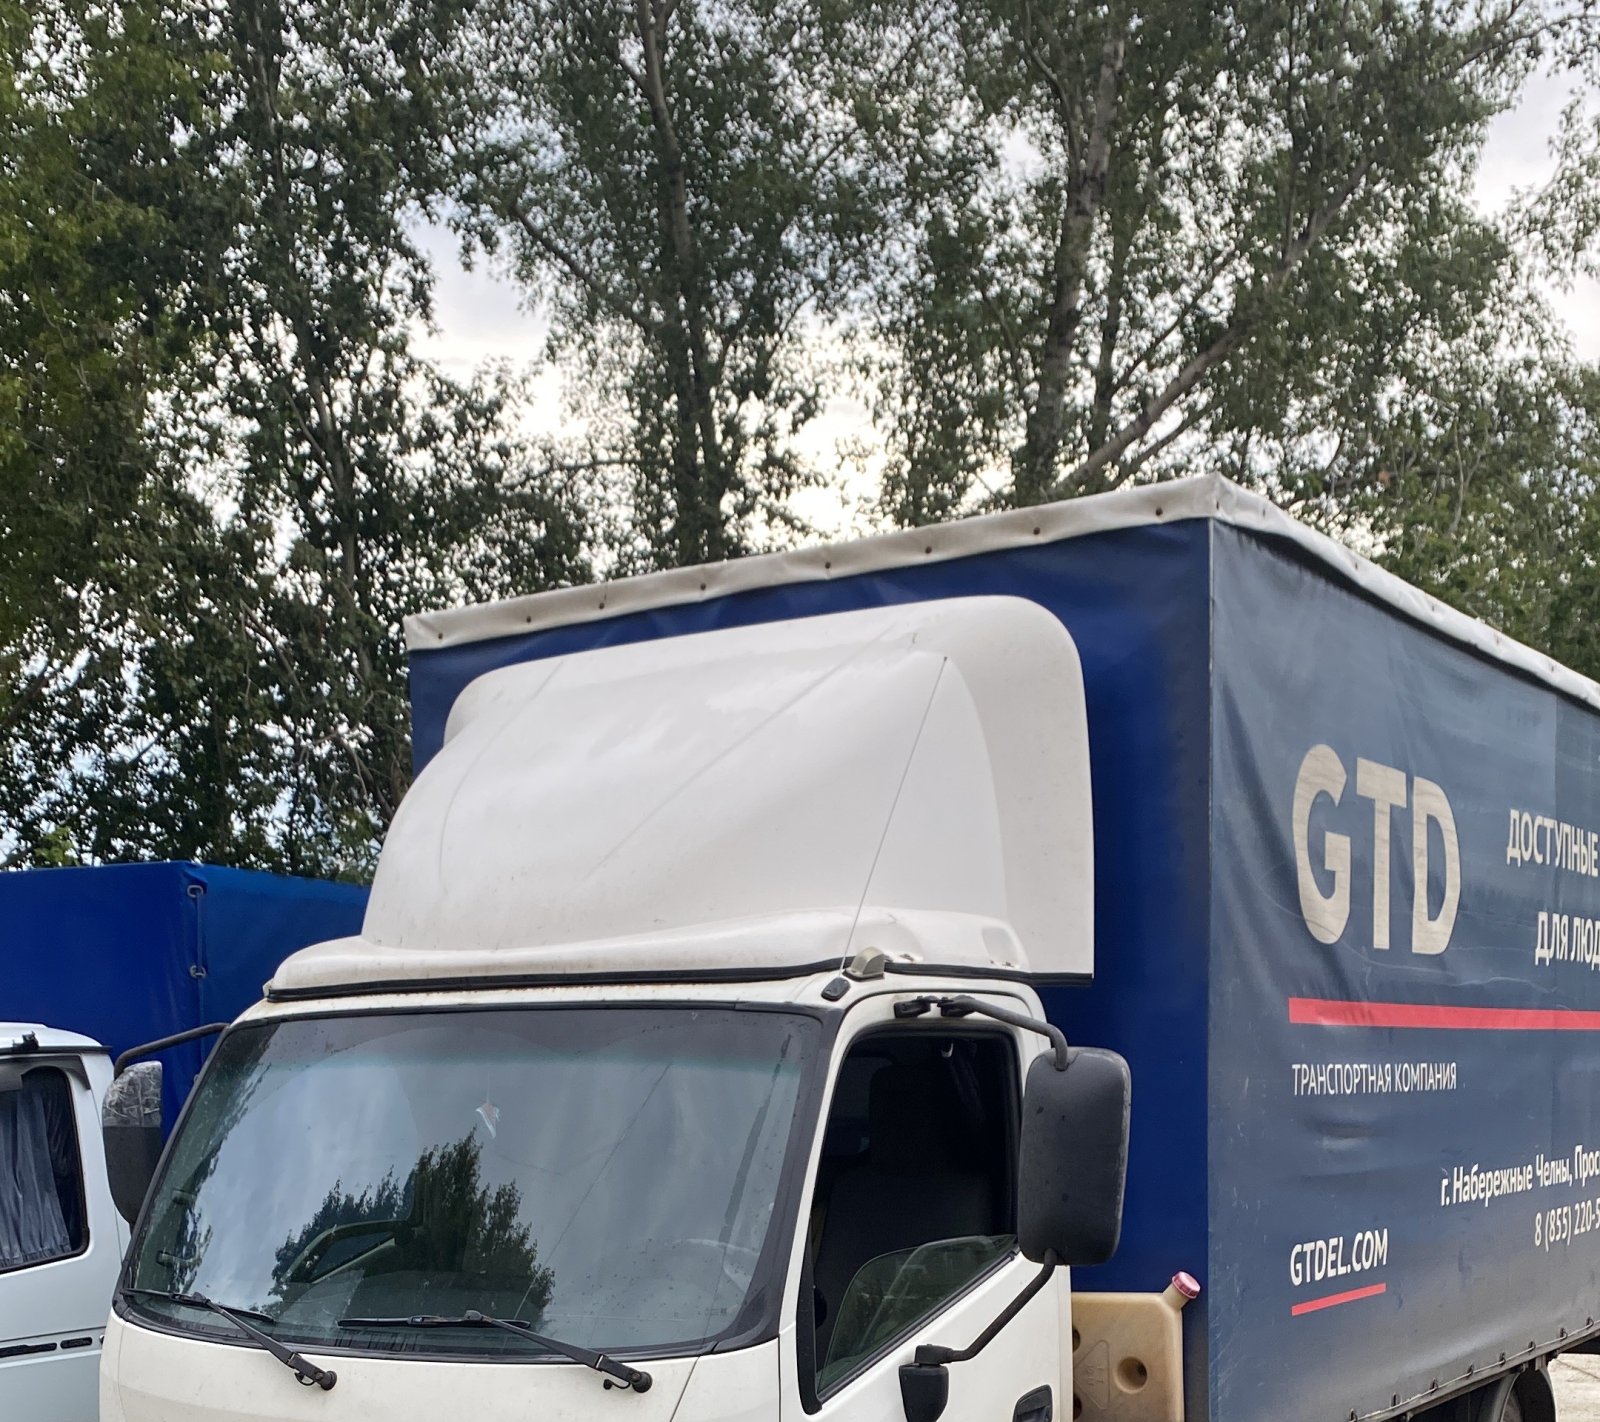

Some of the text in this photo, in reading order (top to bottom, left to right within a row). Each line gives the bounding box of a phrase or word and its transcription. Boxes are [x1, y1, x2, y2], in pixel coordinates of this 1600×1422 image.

[1292, 743, 1461, 955] GTD
[1507, 809, 1598, 877] ДОСТУПНЫЕ
[1535, 911, 1568, 966] ДЛЯ
[1292, 1062, 1457, 1096] ТРАНСПОРТНАЯ КОМПАНИЯ
[1440, 1178, 1450, 1206] г.
[1453, 1163, 1533, 1207] Набережные
[1536, 1153, 1572, 1187] Челны,
[1534, 1212, 1542, 1246] 8
[1545, 1205, 1571, 1252] (855)
[1290, 1228, 1388, 1286] GTDEL.COM
